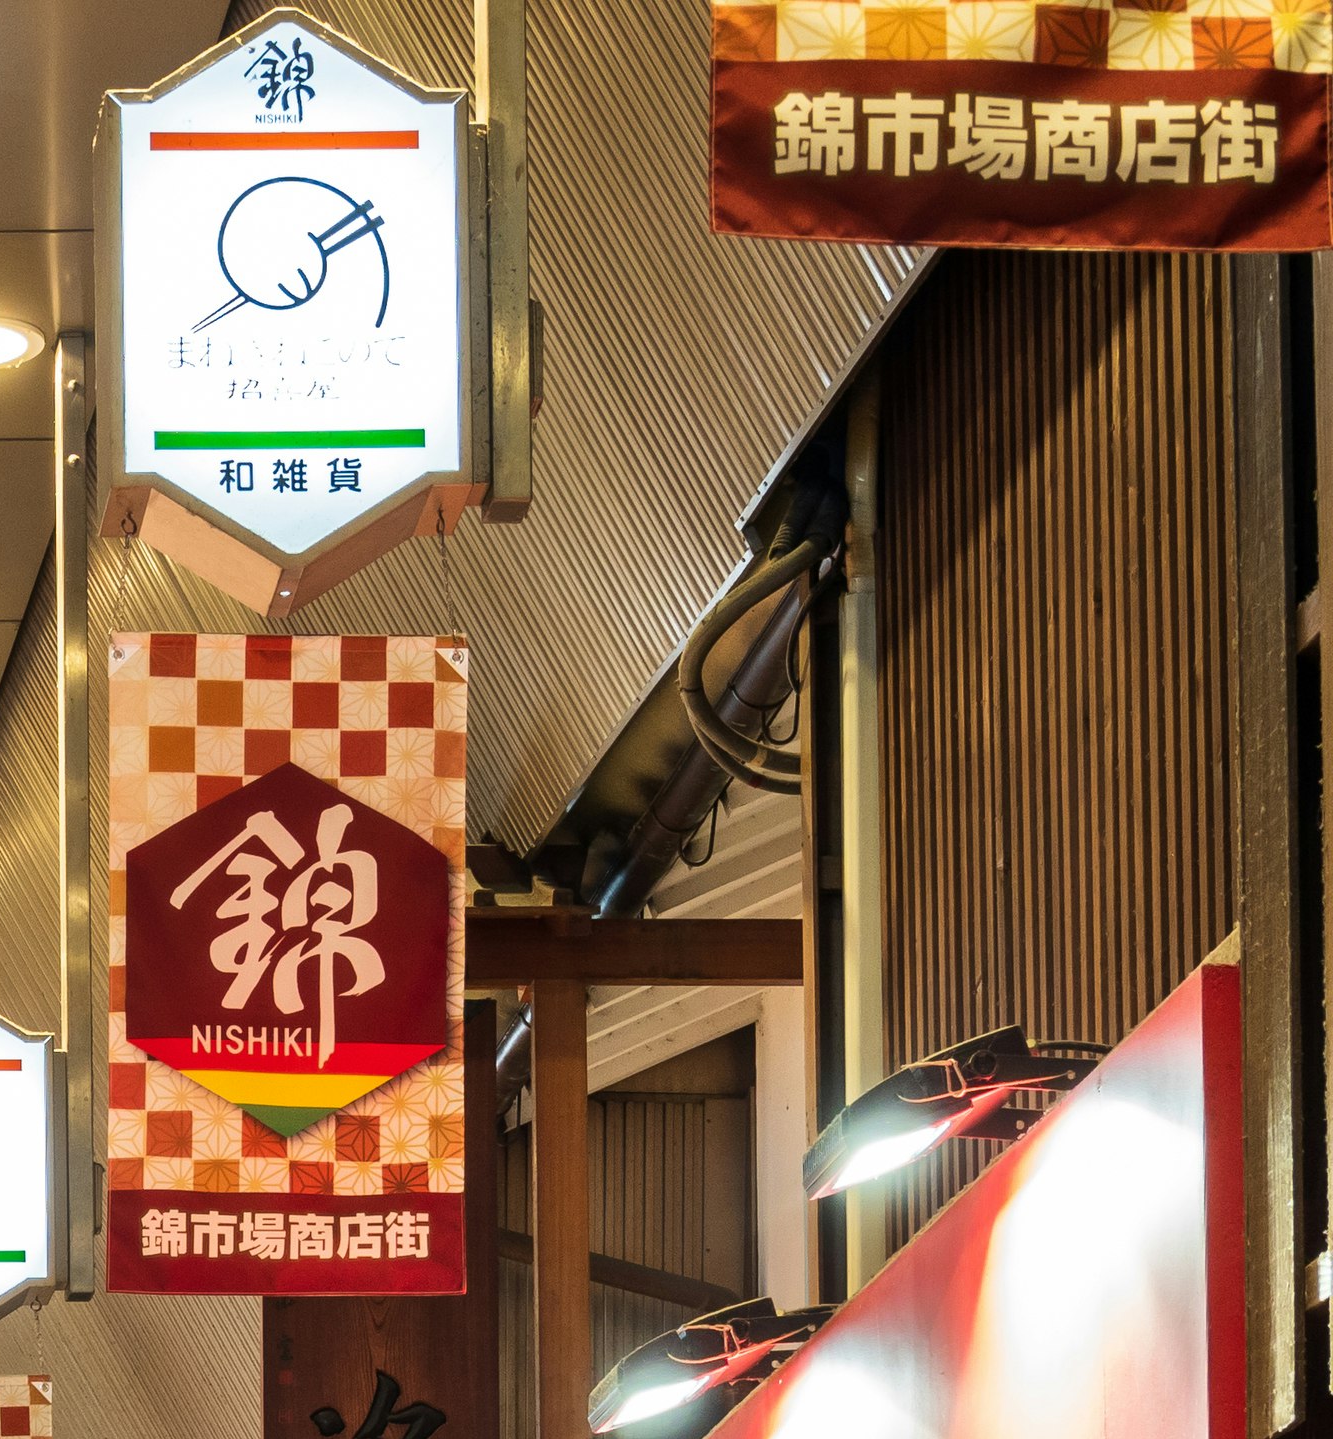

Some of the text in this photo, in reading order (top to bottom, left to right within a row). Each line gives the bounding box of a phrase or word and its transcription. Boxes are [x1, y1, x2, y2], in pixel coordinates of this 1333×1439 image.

[244, 37, 315, 124] 錦
[255, 114, 298, 124] NISHIKI
[774, 91, 1278, 184] 錦市場商店街
[219, 457, 363, 494] 和雑貨
[169, 803, 386, 1069] 錦
[190, 1025, 314, 1057] NISHIKI
[139, 1208, 430, 1260] 錦市場商店街
